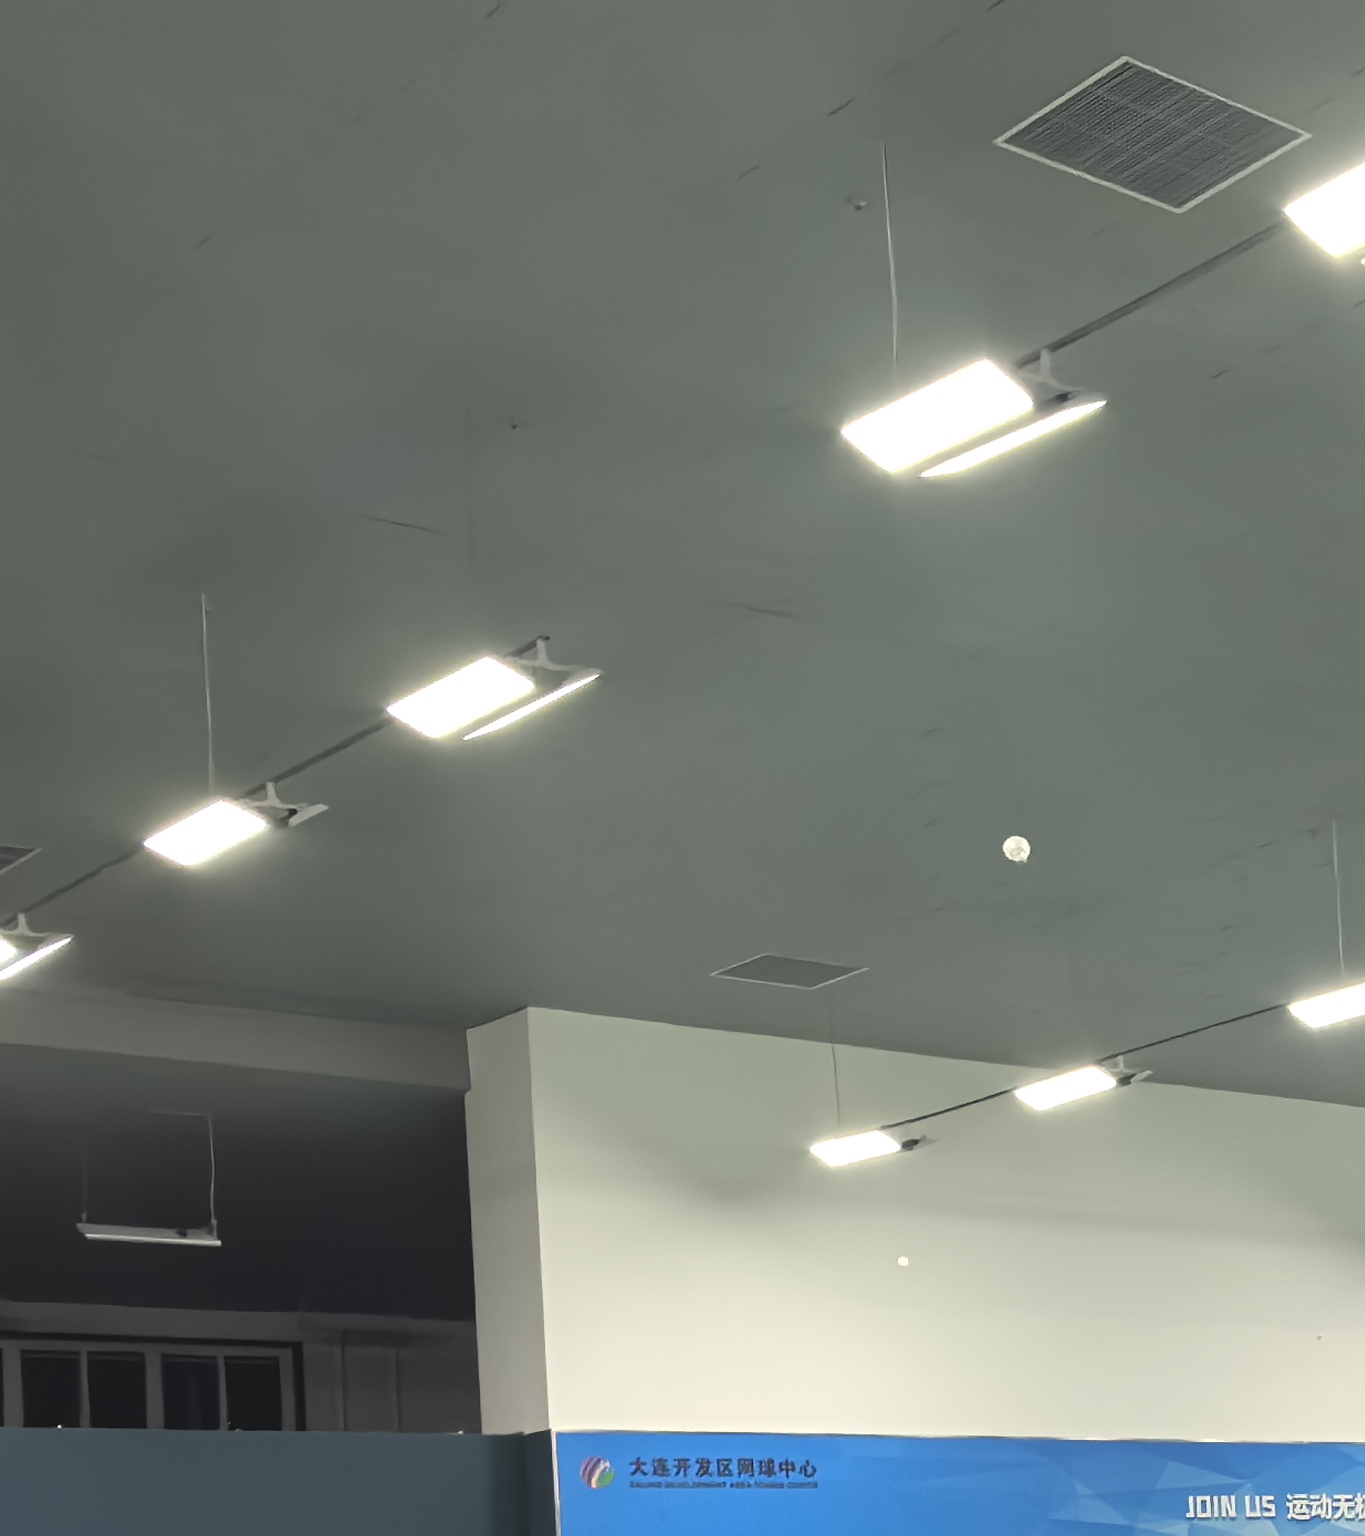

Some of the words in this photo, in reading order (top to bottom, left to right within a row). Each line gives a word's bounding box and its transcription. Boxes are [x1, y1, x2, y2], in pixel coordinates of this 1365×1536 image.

[629, 1456, 818, 1479] 大连开发区网球中心
[1186, 1494, 1237, 1519] JOIN
[1244, 1494, 1276, 1519] US
